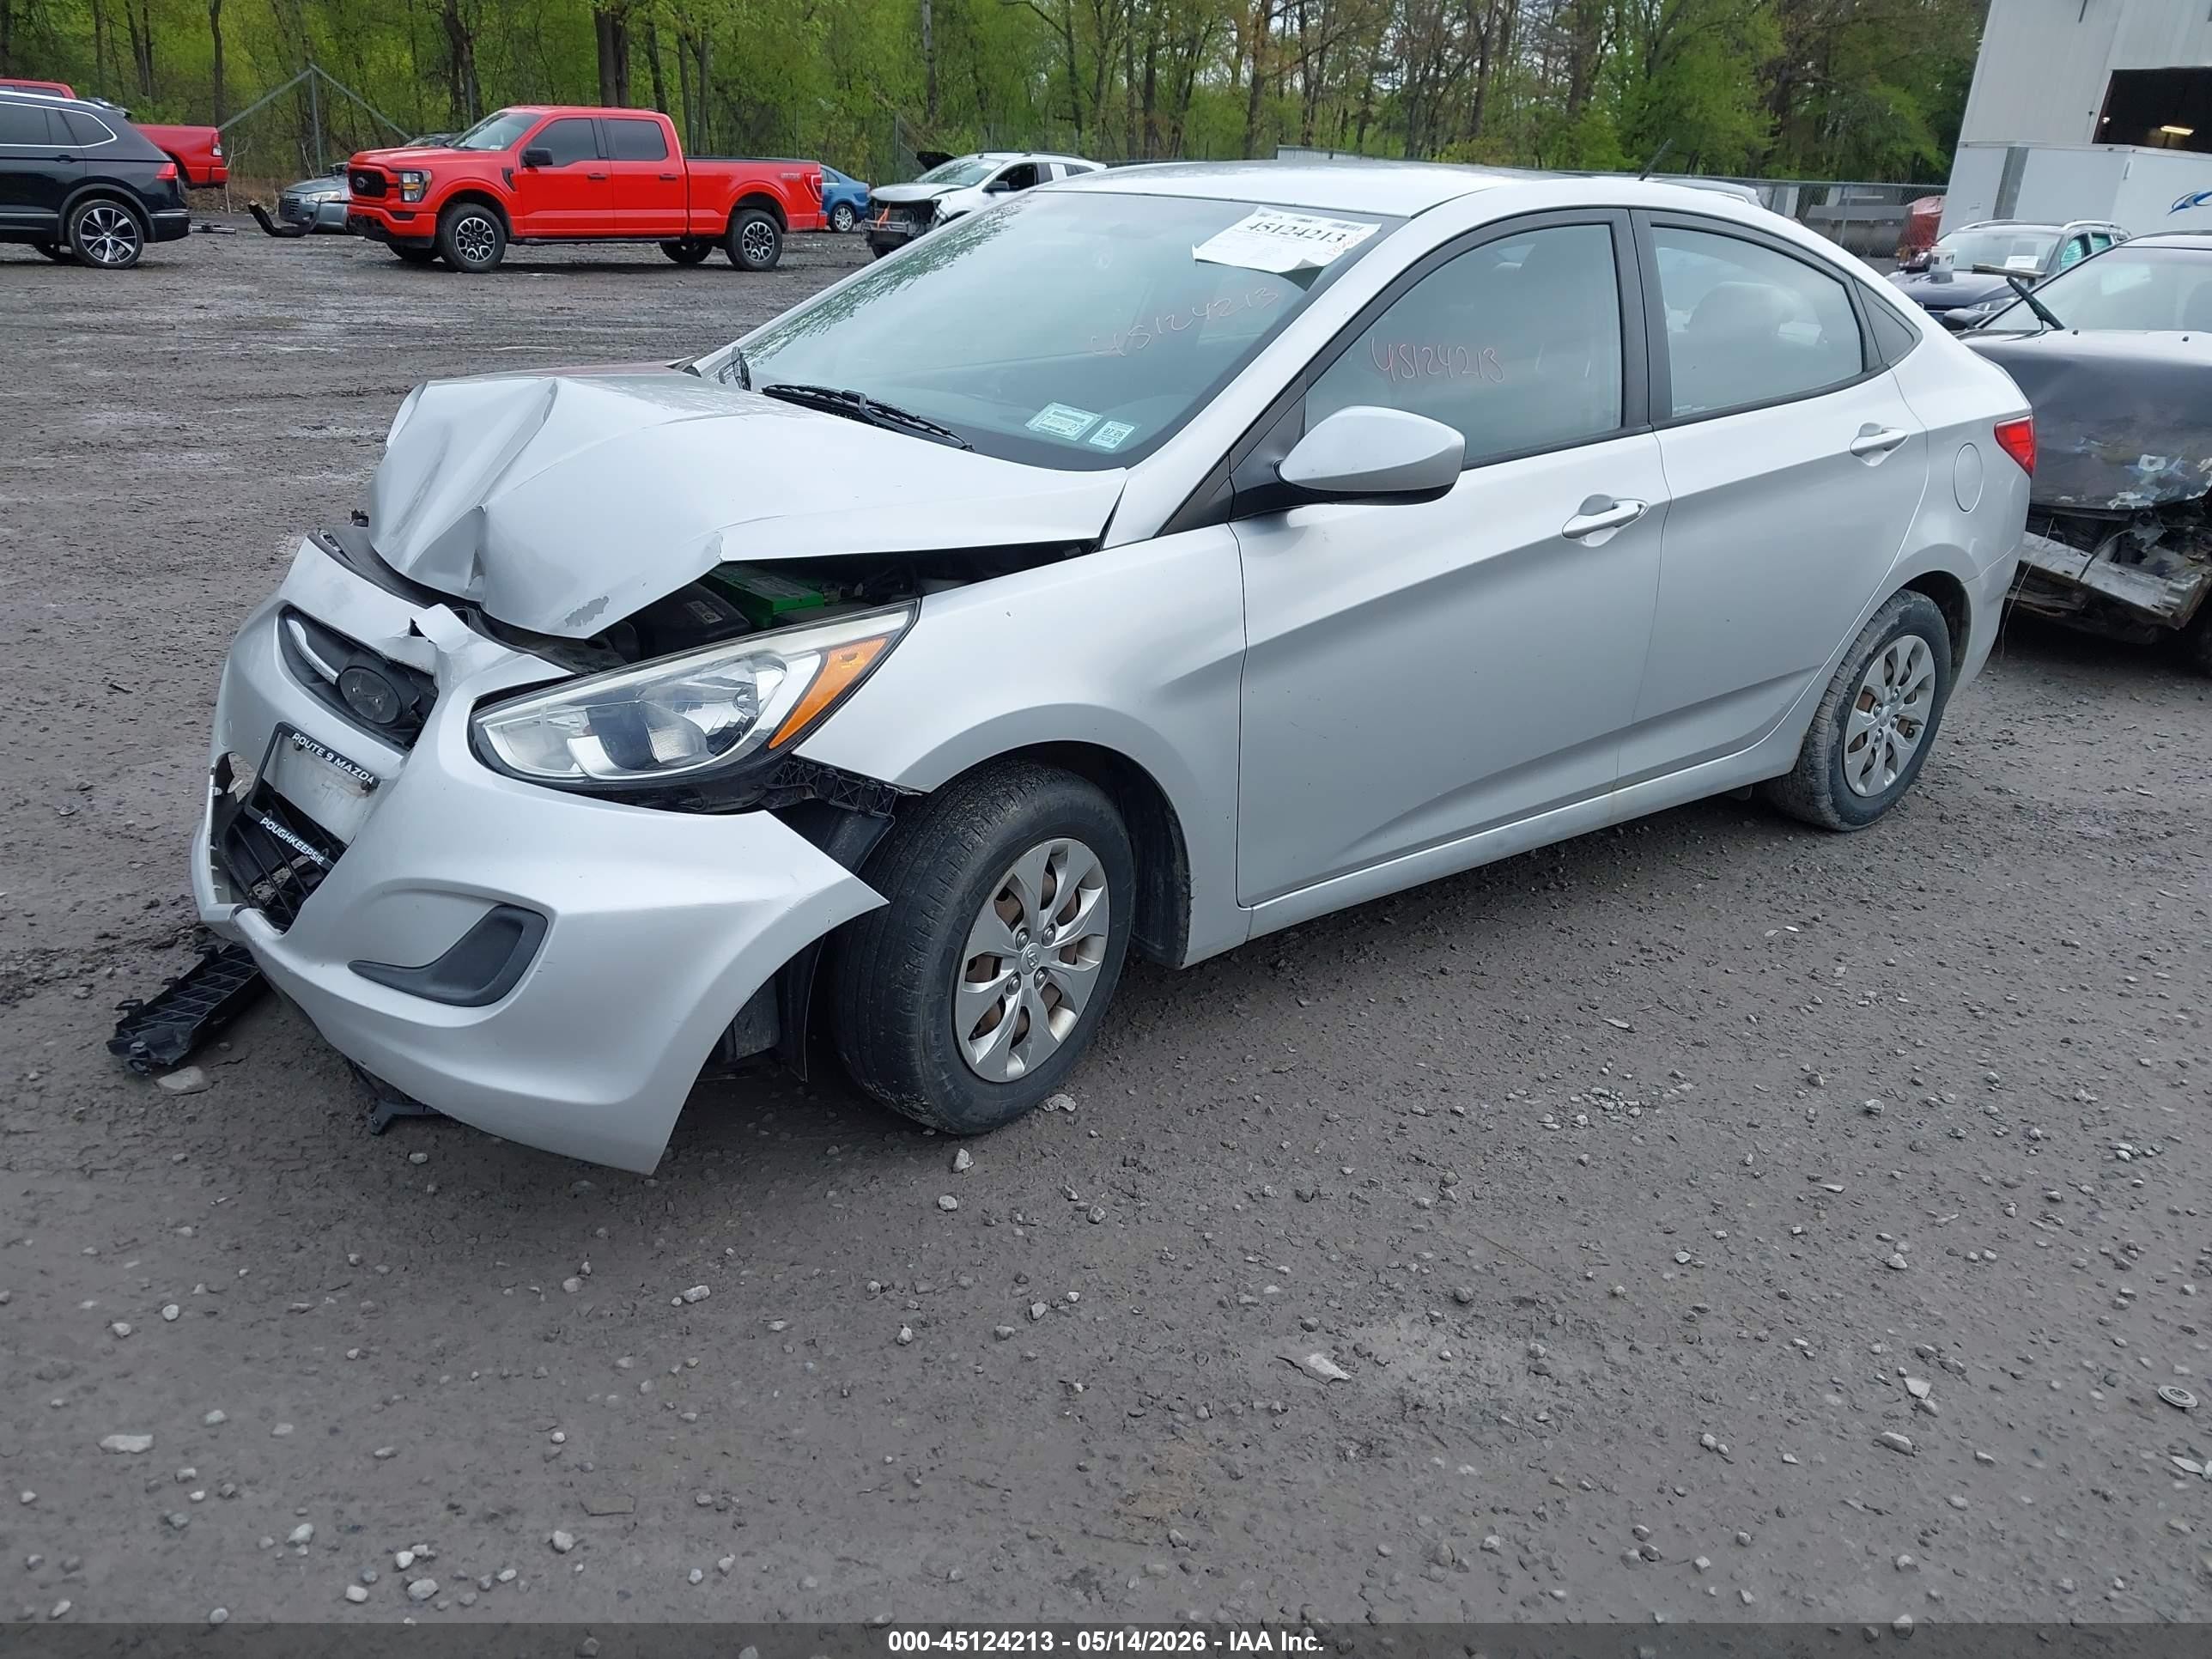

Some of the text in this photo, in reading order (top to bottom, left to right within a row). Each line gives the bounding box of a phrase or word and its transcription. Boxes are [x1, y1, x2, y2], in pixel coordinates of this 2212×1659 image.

[1247, 221, 1347, 243] 45124213
[1091, 287, 1279, 357] 45124213
[1370, 336, 1504, 383] 45124213
[292, 732, 374, 784] ROUTE 9 MAZDA
[259, 817, 325, 866] POUGHKEEPSIE
